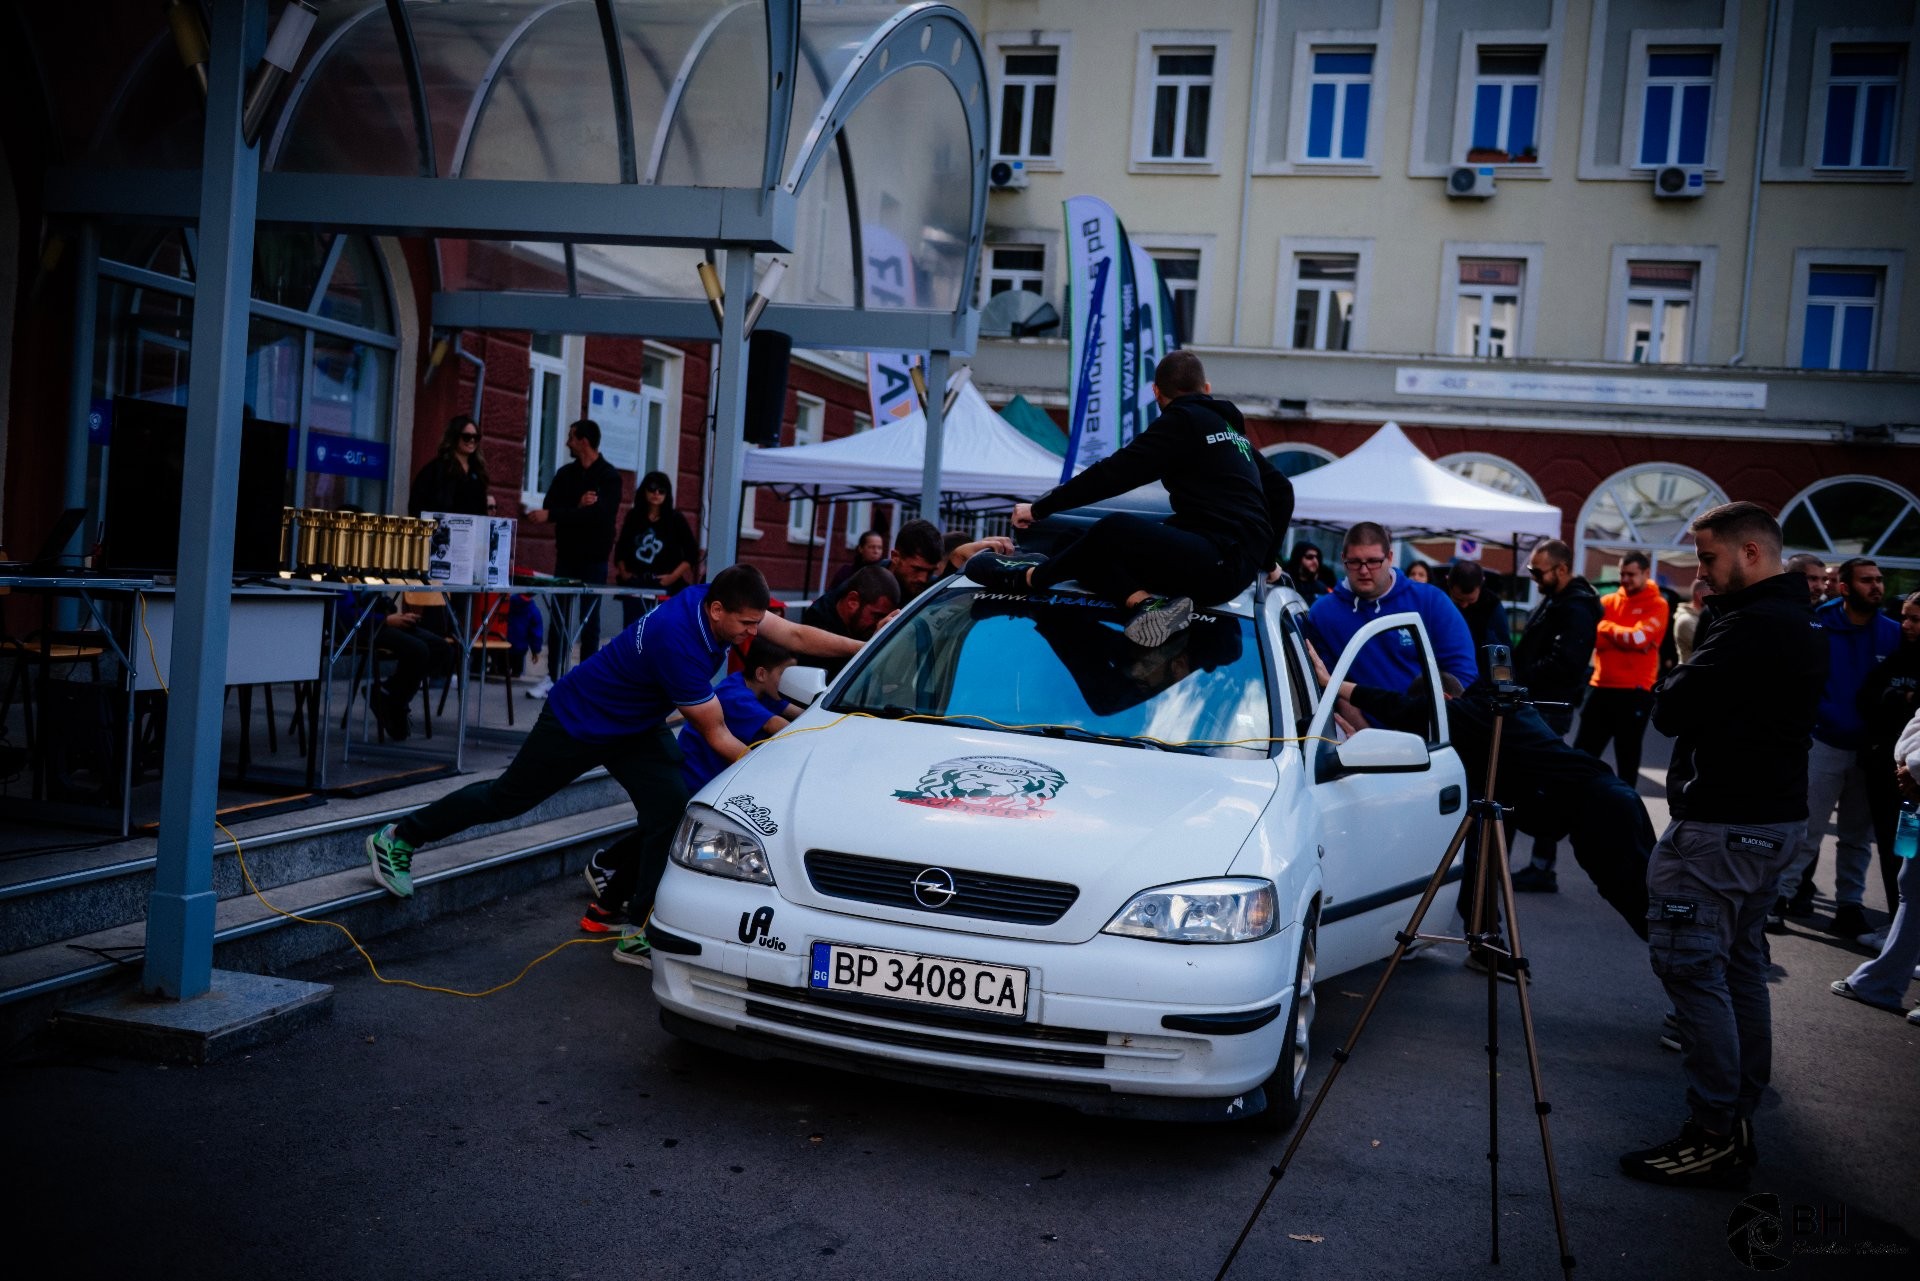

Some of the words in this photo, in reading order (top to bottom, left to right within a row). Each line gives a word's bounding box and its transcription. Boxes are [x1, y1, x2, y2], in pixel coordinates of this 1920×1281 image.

[813, 970, 828, 982] BG
[834, 951, 878, 987] BP
[884, 958, 967, 1001] 3408
[974, 971, 1017, 1009] CA
